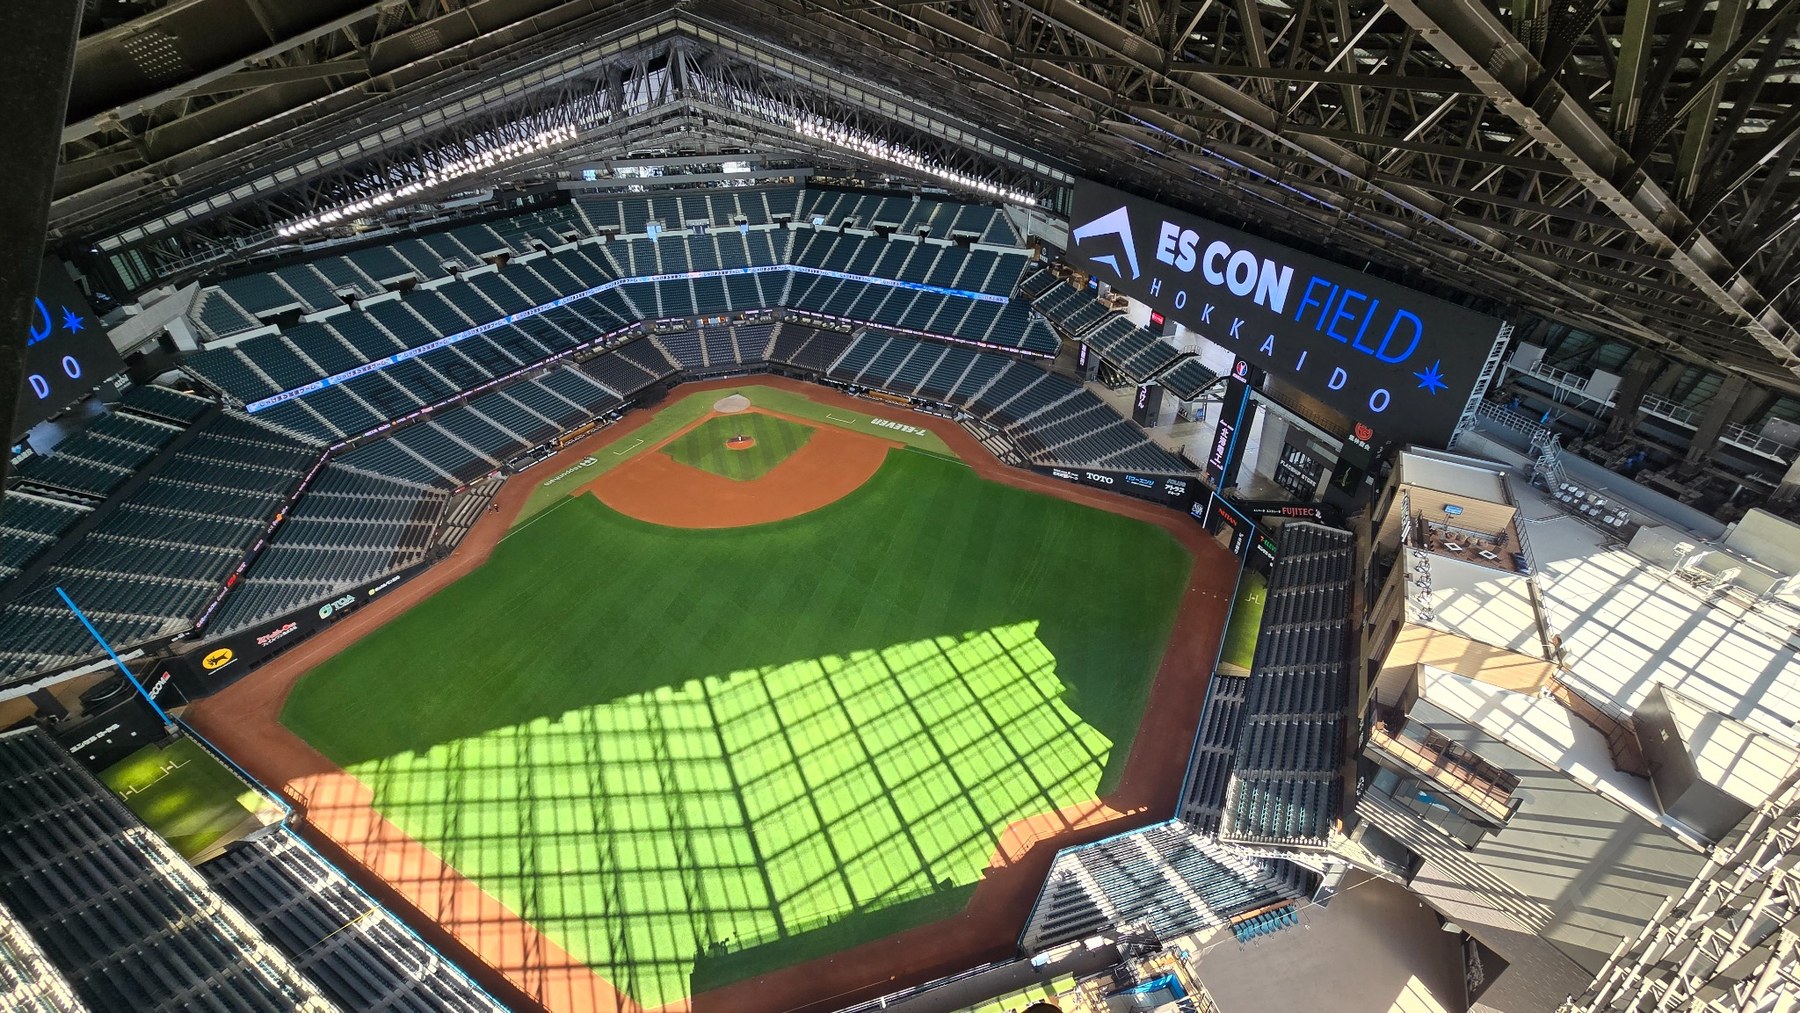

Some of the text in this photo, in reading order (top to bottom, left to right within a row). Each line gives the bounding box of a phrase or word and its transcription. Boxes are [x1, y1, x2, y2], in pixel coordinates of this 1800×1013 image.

[1156, 220, 1423, 364] ES CON FIELD
[1150, 277, 1391, 413] HOKKAIDO
[1086, 472, 1113, 485] TOTO
[1282, 505, 1315, 518] FUJITEC
[331, 594, 355, 608] TOA
